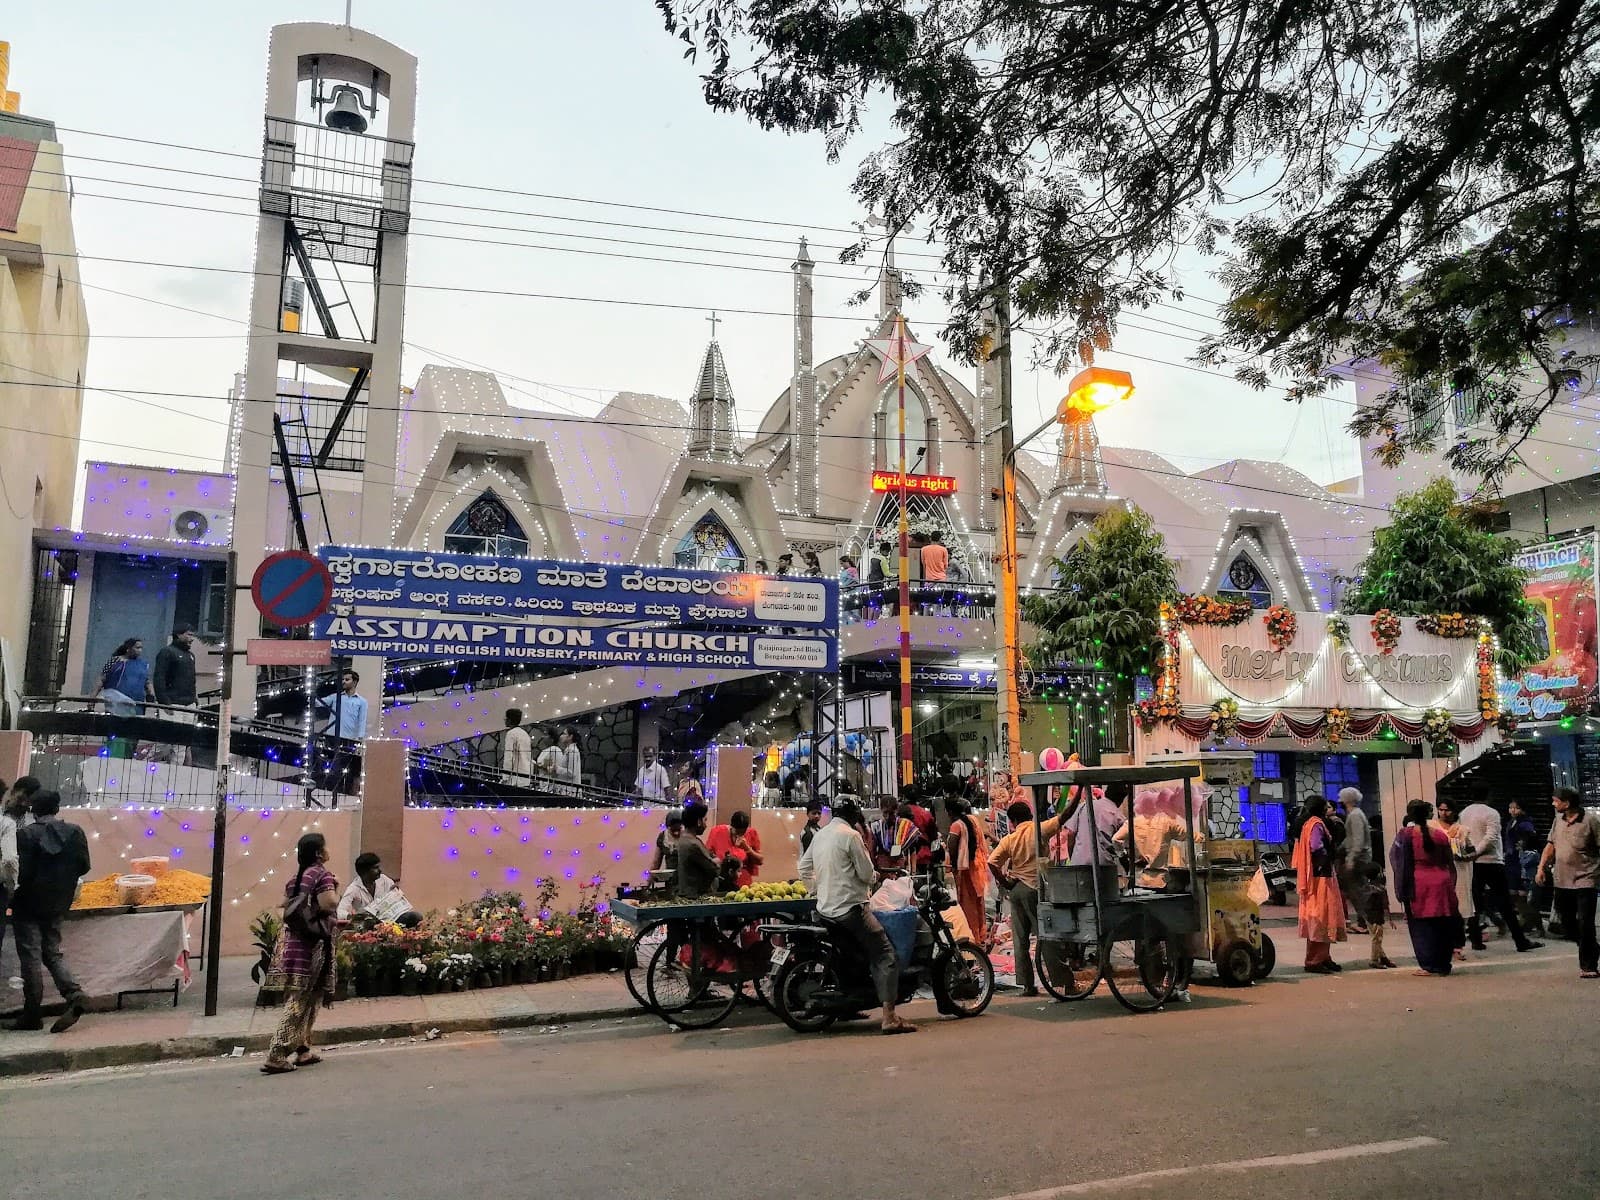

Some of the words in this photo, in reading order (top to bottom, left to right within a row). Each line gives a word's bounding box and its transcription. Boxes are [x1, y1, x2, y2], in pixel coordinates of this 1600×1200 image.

[920, 477, 950, 491] right
[1517, 545, 1579, 569] CHURCH
[537, 565, 607, 588] ಮಾತೆ
[621, 570, 748, 596] ದೇವಾಲಯ
[644, 603, 681, 620] ಮತ್ತು
[326, 617, 592, 646] ASSUMPTION
[606, 631, 749, 652] CHURCH
[331, 639, 430, 653] ASSUMPTION
[434, 644, 500, 656] ENGLISH
[658, 653, 692, 663] HIGH
[696, 654, 750, 666] SCHOOL
[1531, 693, 1568, 719] Year
